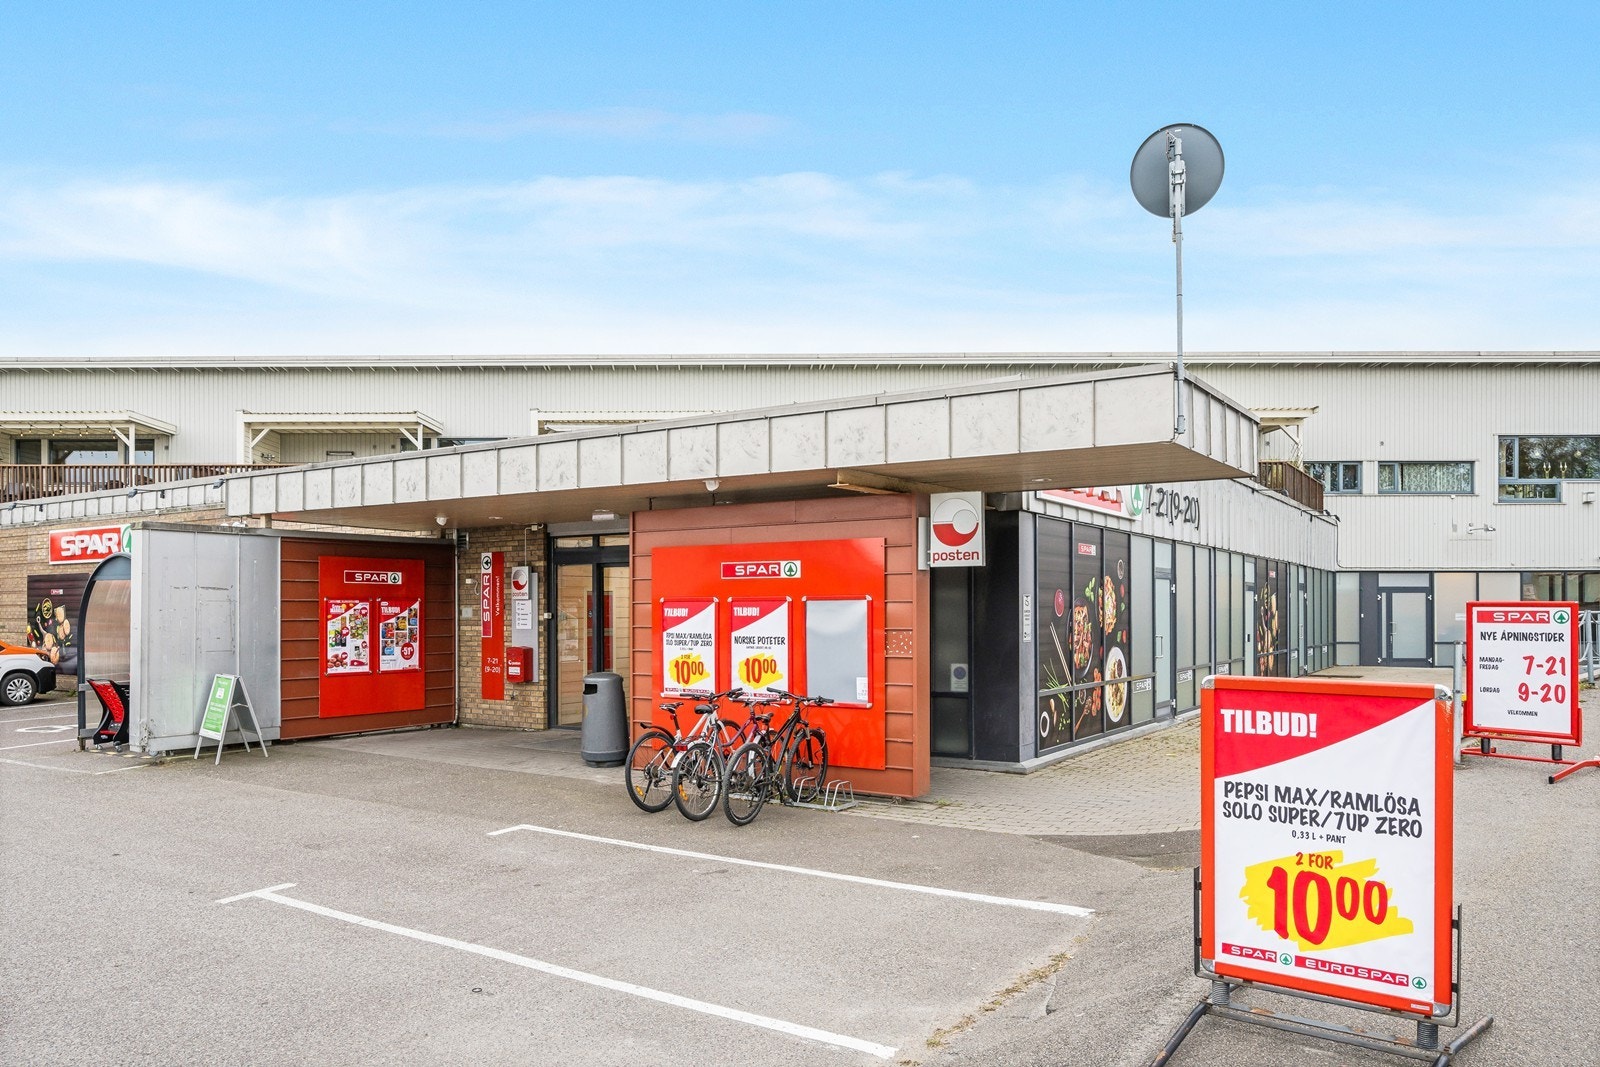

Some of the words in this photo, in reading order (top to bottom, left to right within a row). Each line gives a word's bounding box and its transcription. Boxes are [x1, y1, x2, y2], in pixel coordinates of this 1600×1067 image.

[61, 533, 119, 557] SPAR
[932, 549, 980, 563] posten
[735, 565, 780, 576] SPAR
[354, 573, 388, 581] SPAR
[663, 607, 689, 617] TILBUD!
[733, 606, 760, 617] TILBUD!
[1493, 612, 1549, 622] SPAR
[734, 636, 756, 645] NORSKE
[757, 636, 786, 645] POTETER
[1480, 631, 1498, 641] NYE
[1500, 630, 1565, 642] ÅPNINGSTIDER
[1522, 655, 1566, 676] 7-21
[1136, 680, 1148, 690] SPAR
[1480, 686, 1501, 694] LØRDAG
[1518, 682, 1566, 704] 9-20
[1507, 709, 1539, 717] VELKOMMEN
[1220, 708, 1318, 739] TILBUD!
[1223, 780, 1269, 802] PEPSI
[1274, 785, 1422, 817] MAX/RAMLÖSA
[1222, 801, 1263, 821] SOLO
[1268, 804, 1370, 833] SUPER/7UP
[1375, 816, 1423, 839] ZERO
[1312, 832, 1317, 840] L
[1326, 833, 1347, 844] PANT
[1295, 851, 1304, 866] 2
[1308, 853, 1334, 870] FOR
[1230, 945, 1277, 963] SPAR
[1305, 958, 1409, 987] EUROSPAR
